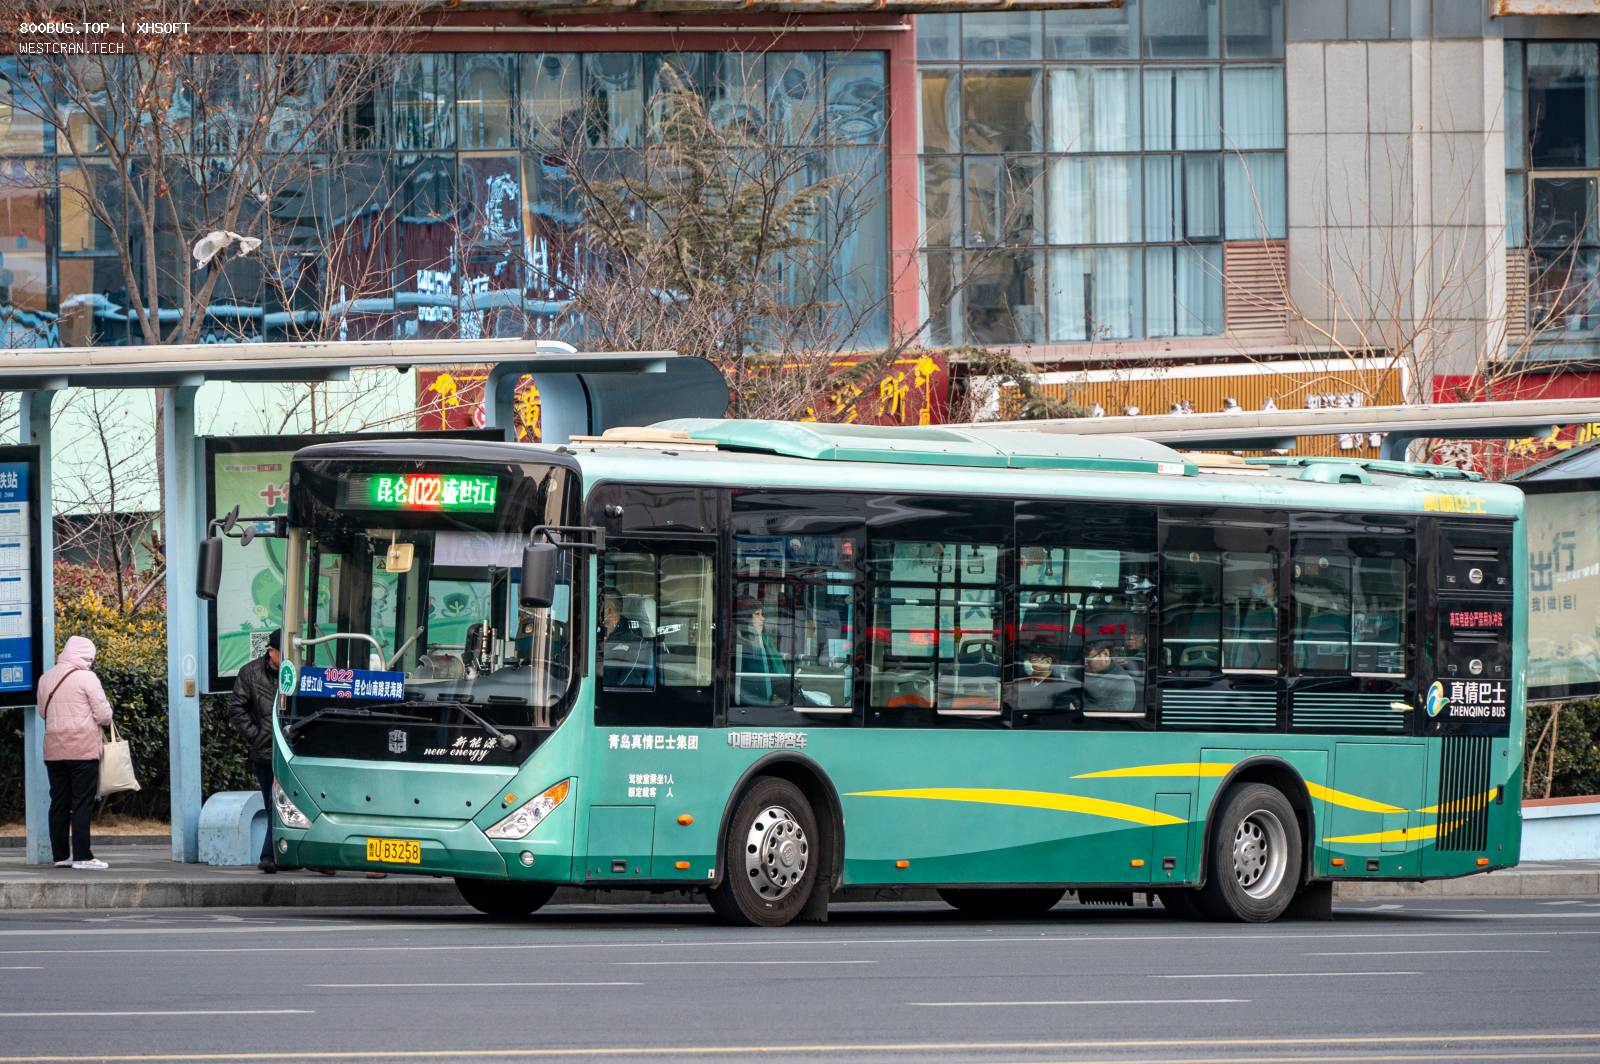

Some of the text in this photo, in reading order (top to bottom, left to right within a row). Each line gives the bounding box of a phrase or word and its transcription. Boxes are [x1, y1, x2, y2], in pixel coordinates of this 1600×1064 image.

[324, 667, 354, 683] 1022
[300, 675, 323, 693] 盛世江山
[1450, 681, 1506, 704] 真情巴士
[1449, 705, 1506, 717] ZHENQING BUS
[452, 735, 499, 749] 新能源
[608, 734, 699, 750] 青岛真情巴士集团
[423, 747, 490, 762] new energy
